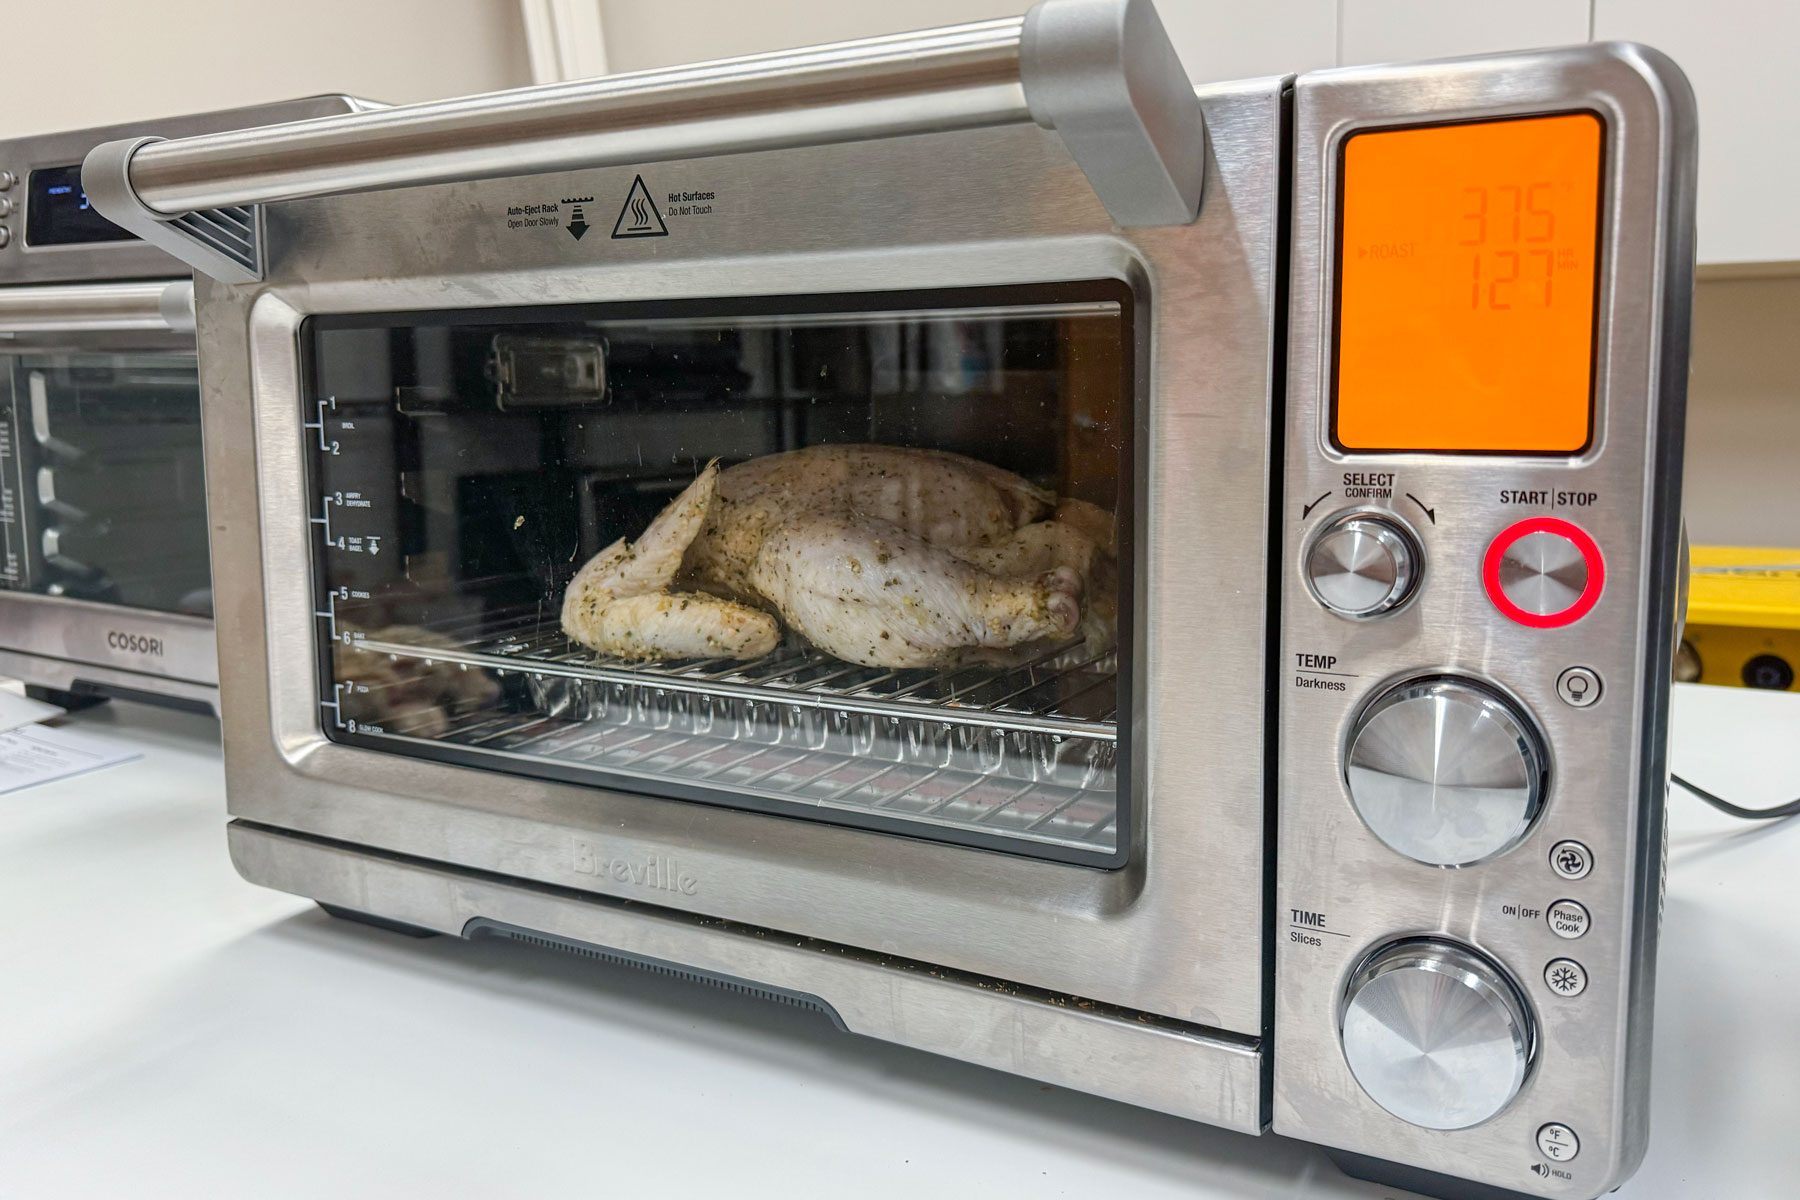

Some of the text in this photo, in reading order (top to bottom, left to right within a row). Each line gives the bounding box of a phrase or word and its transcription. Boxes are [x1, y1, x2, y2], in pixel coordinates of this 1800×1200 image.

[668, 191, 715, 203] Hot Surfaces
[507, 203, 559, 217] Auto-Eject Rack
[668, 204, 713, 216] Do Not Touch
[1459, 182, 1555, 247] 375
[507, 216, 559, 229] Open Door Slowly
[330, 396, 336, 410] 1
[332, 441, 340, 455] 2
[1343, 473, 1395, 487] SELECT
[335, 491, 343, 506] 3
[1345, 487, 1392, 499] CONFIRM
[338, 536, 345, 550] 4
[341, 586, 349, 600] 5
[107, 631, 164, 657] COSORI
[343, 630, 351, 645] 6
[1296, 654, 1337, 669] TEMP
[346, 681, 353, 694] 7
[1295, 677, 1346, 692] Darkness
[348, 719, 356, 733] 8
[572, 839, 698, 896] Breville
[1290, 909, 1326, 928] TIME
[1553, 909, 1583, 923] Phase
[1555, 921, 1580, 934] Cook
[1289, 931, 1322, 947] Slices
[1551, 1169, 1572, 1180] HOLD
